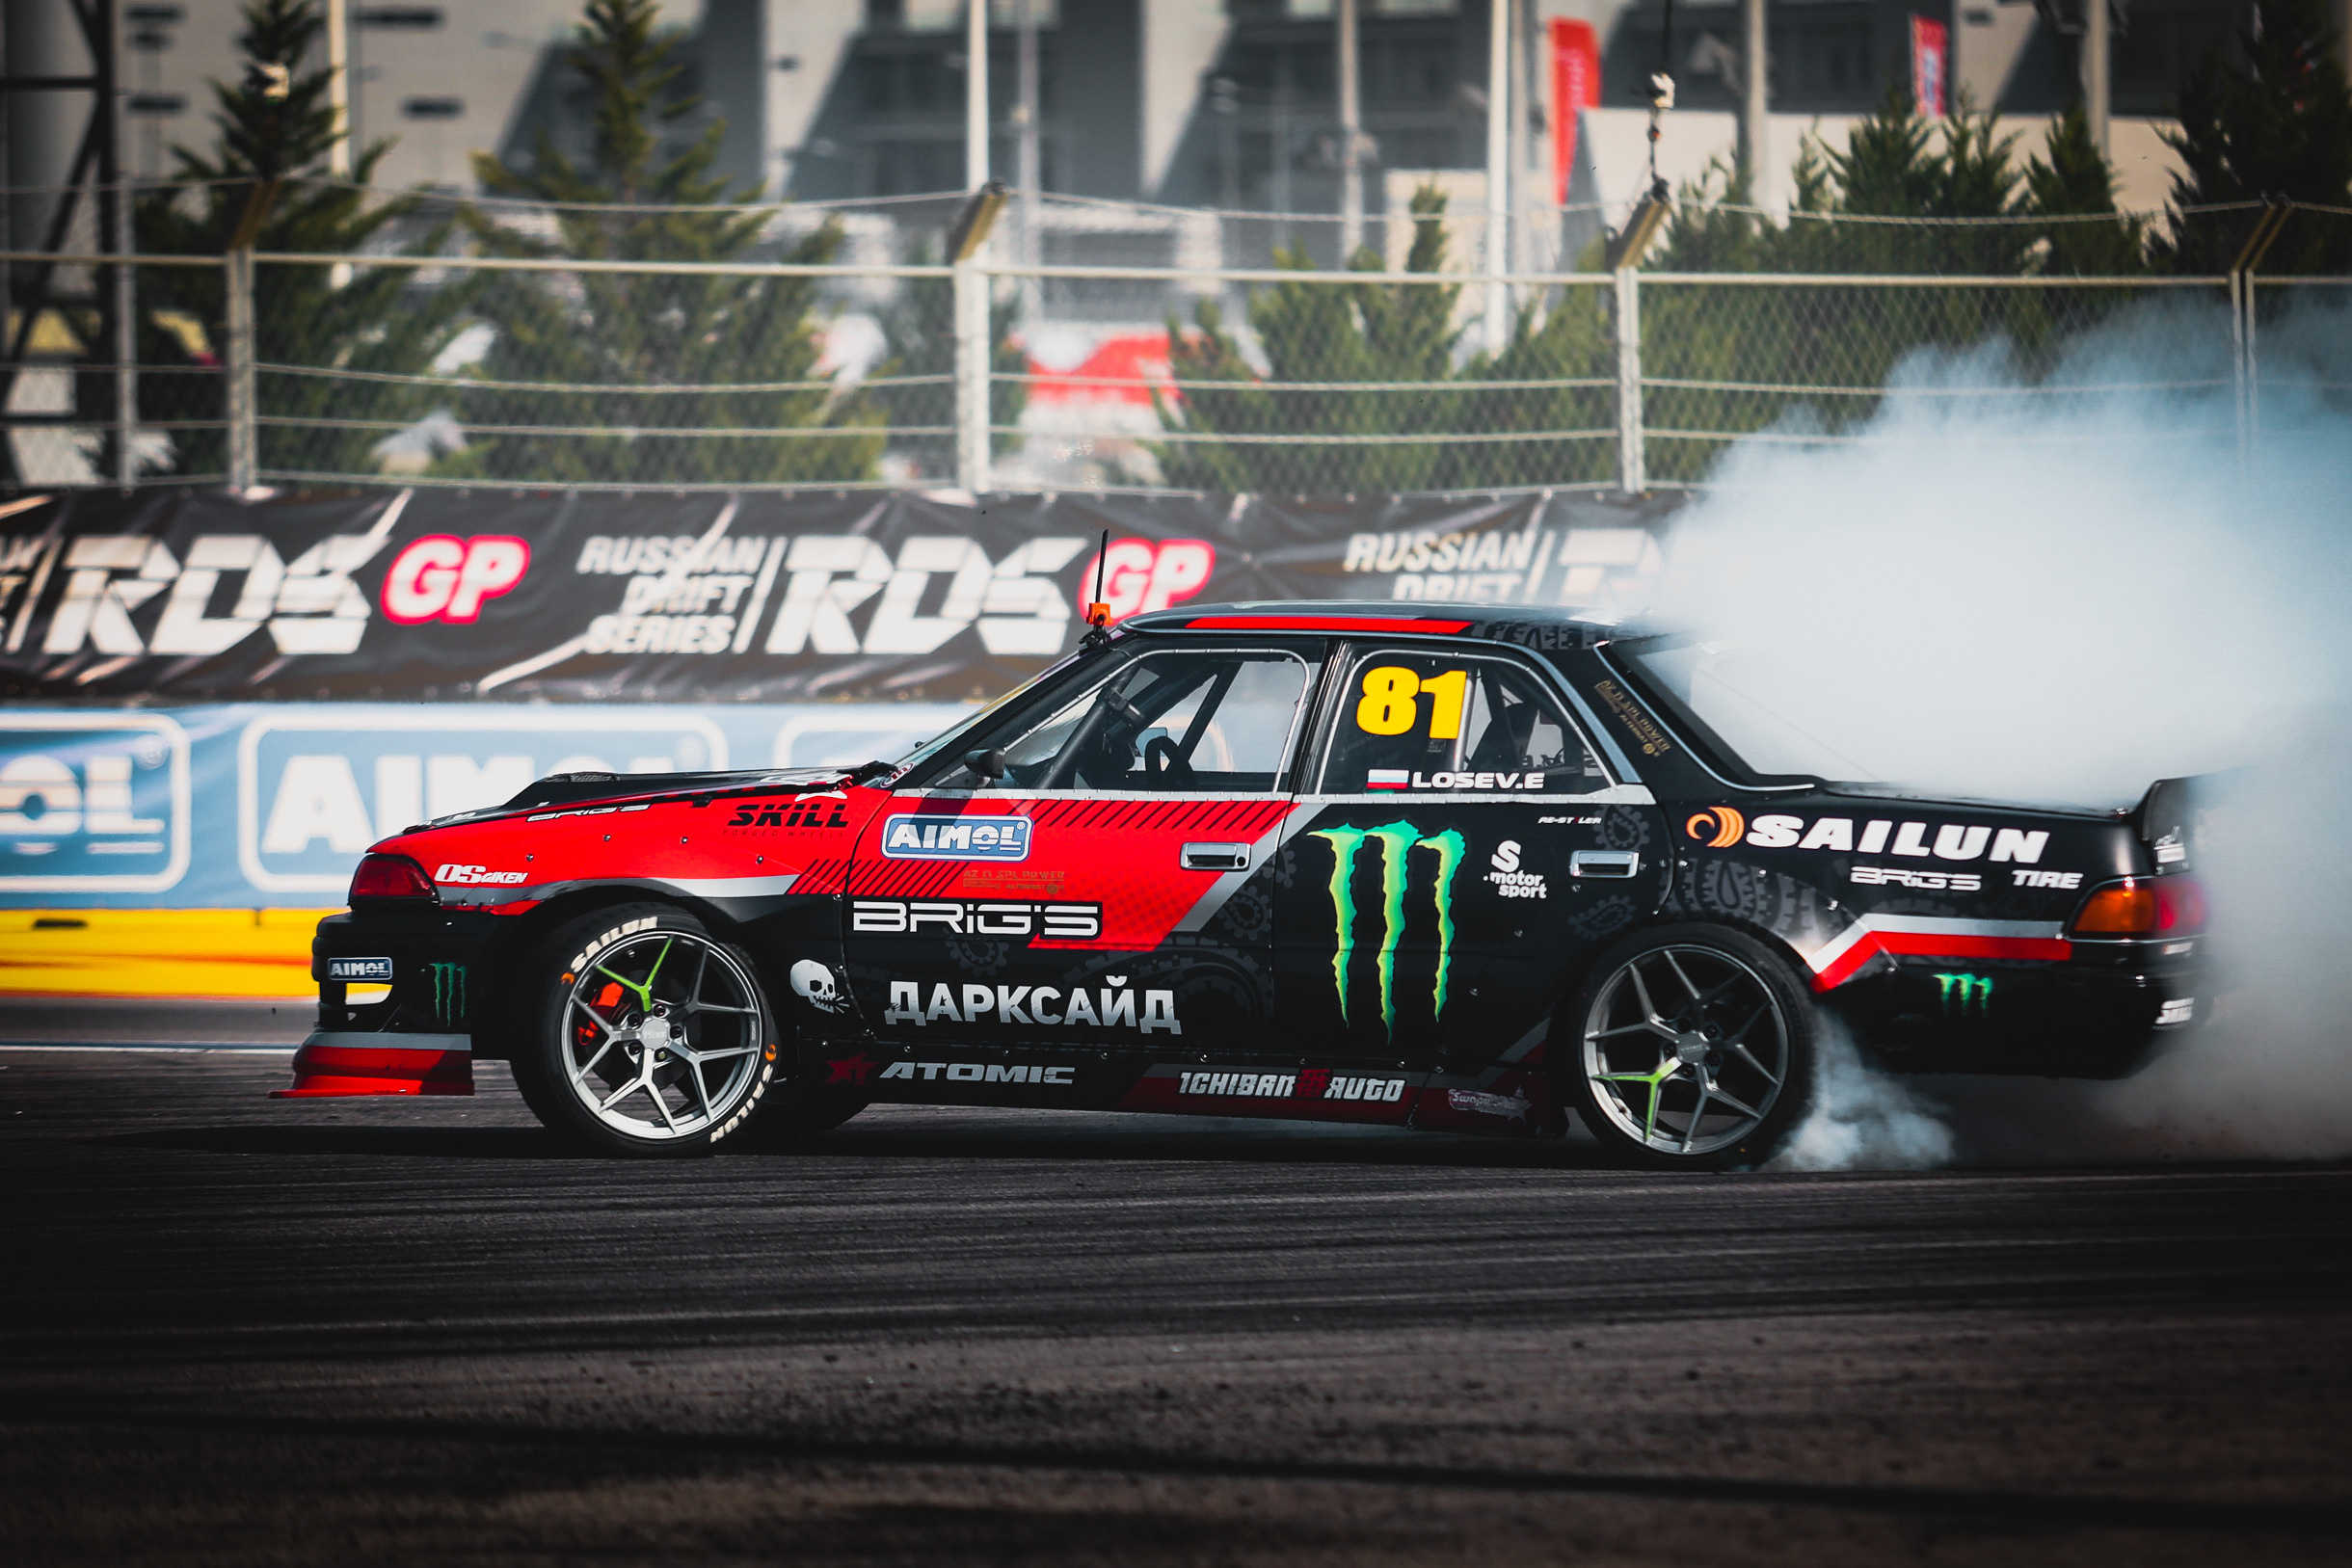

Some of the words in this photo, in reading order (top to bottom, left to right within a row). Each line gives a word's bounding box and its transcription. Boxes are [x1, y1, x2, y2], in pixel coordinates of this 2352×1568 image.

[1343, 531, 1537, 573] RUSSIAN
[42, 535, 388, 654] RDS
[382, 534, 529, 624] GP
[764, 536, 1089, 654] RDS
[1078, 538, 1216, 625] GP
[582, 614, 737, 654] SERIES
[1356, 666, 1467, 739] 81
[1412, 771, 1545, 789] LOSEV.E
[727, 804, 849, 827] SKILL
[788, 830, 844, 838] WHEELS
[888, 823, 1022, 852] AIMOL
[1746, 813, 2050, 864] SAILUN
[435, 864, 486, 884] OS
[2012, 869, 2083, 890] TIRE
[1498, 883, 1547, 898] sport
[331, 962, 389, 976] AIMOL
[885, 975, 1182, 1035] ДАРКСАЙД
[879, 1061, 1076, 1084] ATOMIC
[1178, 1072, 1296, 1097] ICHIBAN
[1323, 1076, 1406, 1103] AUTO
